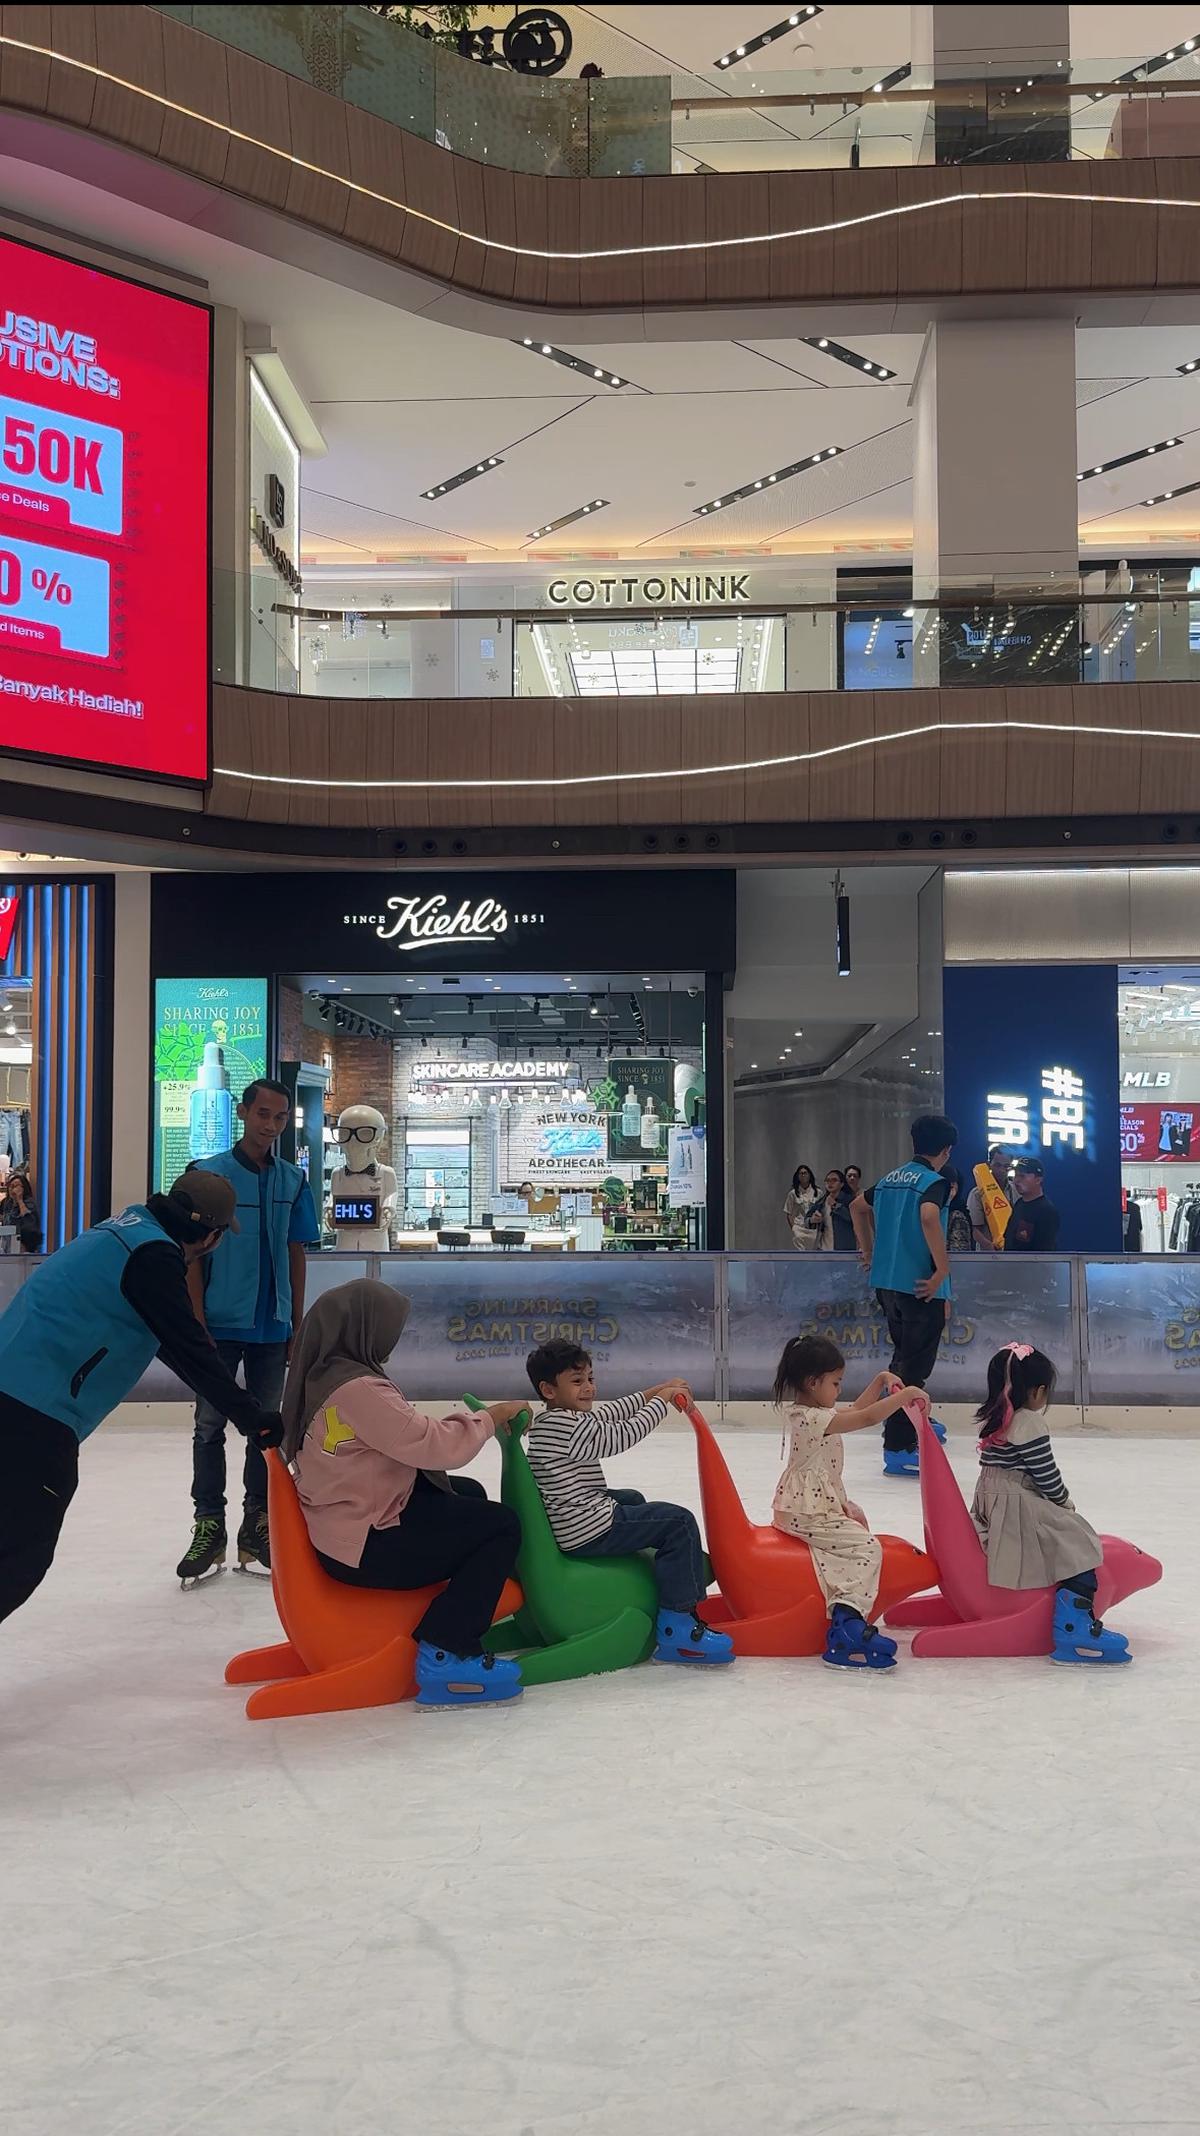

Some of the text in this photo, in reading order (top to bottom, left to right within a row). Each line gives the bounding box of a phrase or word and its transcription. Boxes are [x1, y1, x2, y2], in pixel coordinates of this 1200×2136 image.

[0, 338, 120, 399] TIONS:
[3, 416, 104, 496] 50K
[13, 494, 50, 511] Deals
[549, 575, 750, 603] COTTONINK
[10, 624, 45, 640] Items
[69, 687, 142, 718] Hadiah!
[344, 895, 545, 941] SINCE Kiehl's 1851
[164, 1007, 261, 1020] SHARING JOY
[164, 1023, 261, 1036] SICE 1851
[412, 1062, 569, 1079] SKINCARE ACADEMY
[1123, 1072, 1171, 1087] MLB
[1042, 1066, 1084, 1150] #BE
[536, 1112, 567, 1126] NEW
[570, 1112, 607, 1127] YORK
[528, 1158, 611, 1168] APOTHECAR
[335, 1204, 373, 1218] EHL'S
